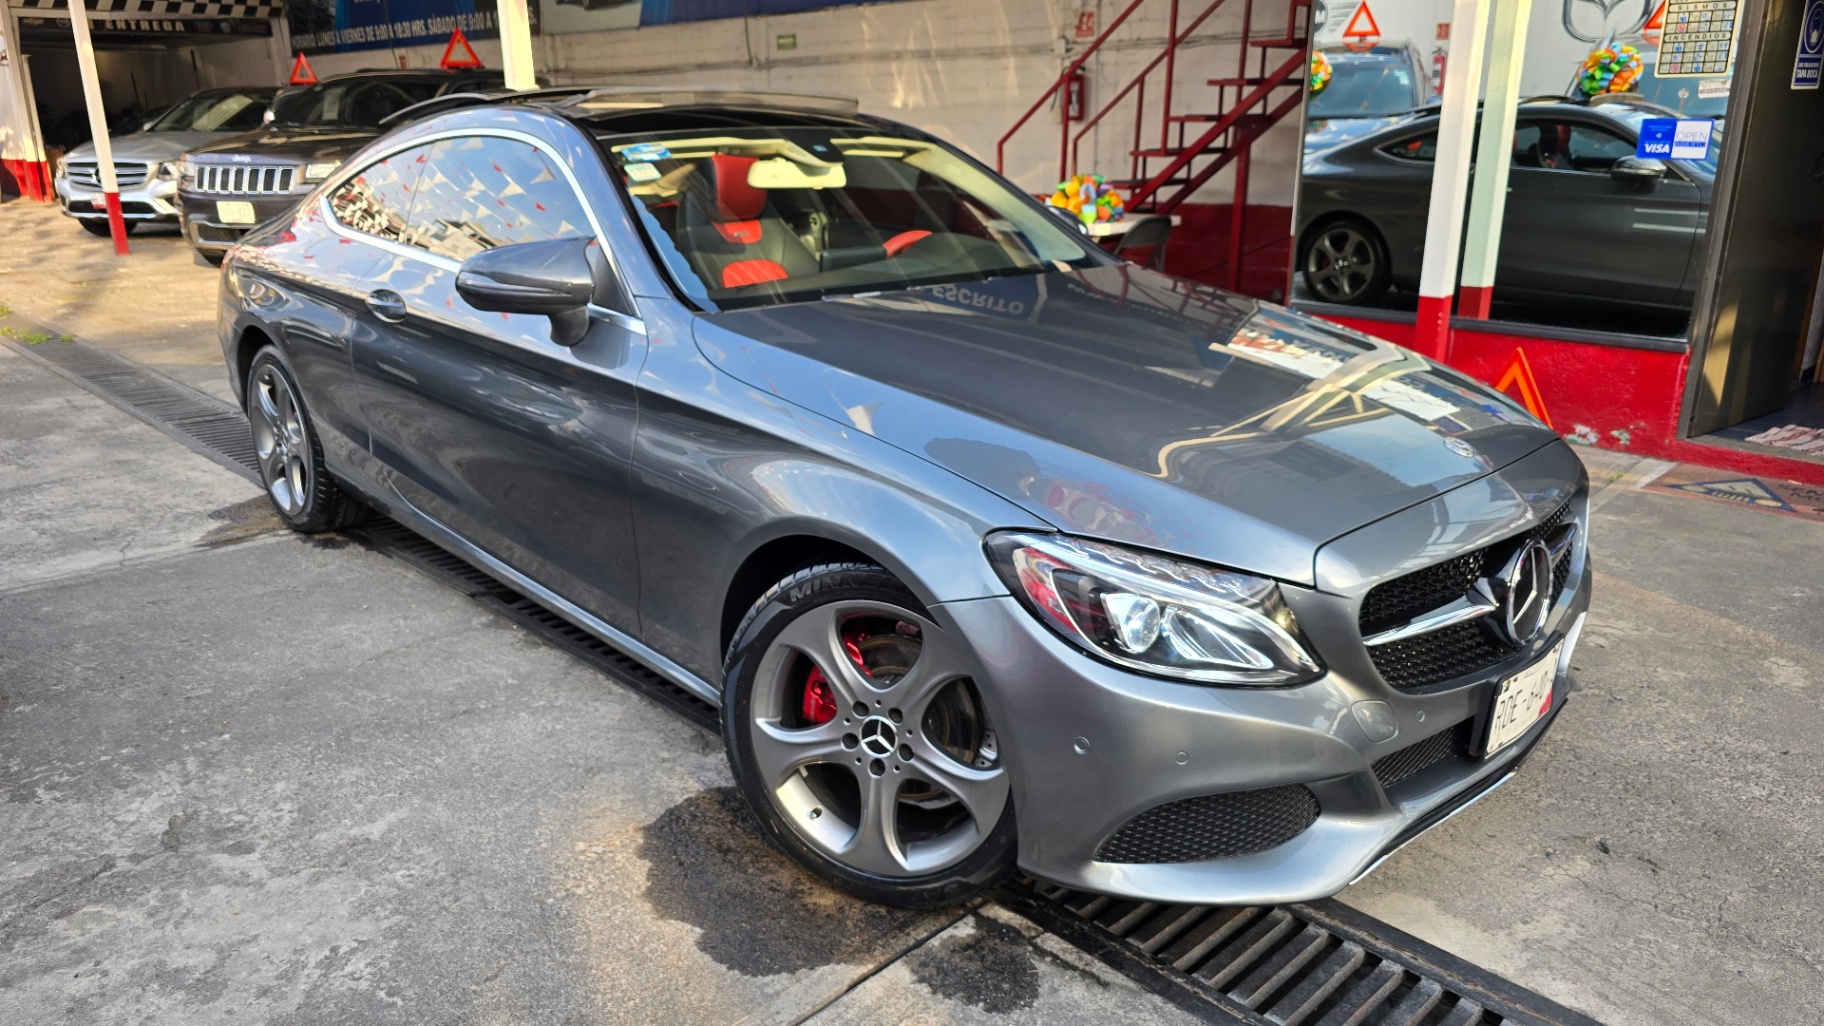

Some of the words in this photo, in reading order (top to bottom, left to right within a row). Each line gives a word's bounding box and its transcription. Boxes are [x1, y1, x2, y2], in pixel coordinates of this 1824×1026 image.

[1677, 3, 1728, 11] SISMOS
[106, 19, 186, 32] ENTREGA
[317, 31, 335, 47] LUNES
[341, 27, 366, 44] VIERNES
[366, 25, 375, 42] DE
[428, 14, 456, 34] SÁBADO
[457, 14, 468, 31] DE
[468, 11, 485, 30] 9:00
[486, 10, 492, 29] A
[1676, 131, 1708, 140] OPEN
[1644, 143, 1670, 153] VISA
